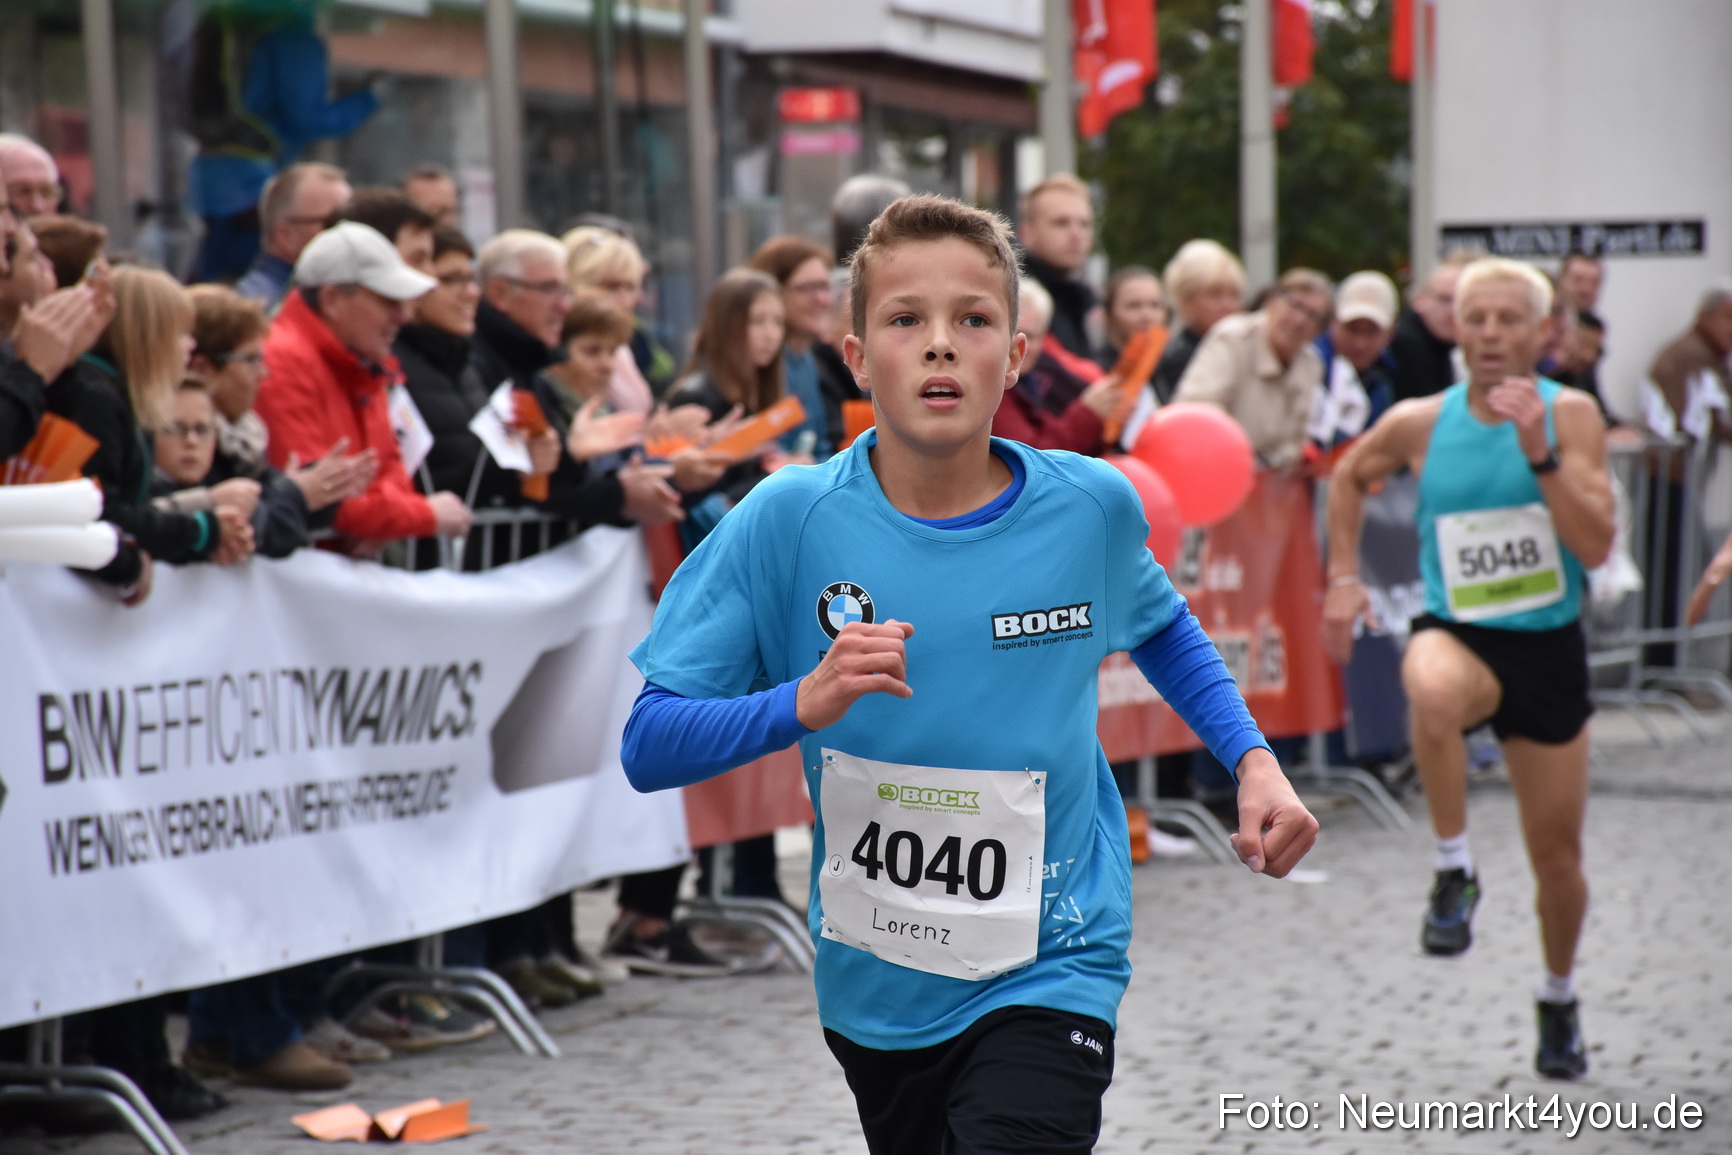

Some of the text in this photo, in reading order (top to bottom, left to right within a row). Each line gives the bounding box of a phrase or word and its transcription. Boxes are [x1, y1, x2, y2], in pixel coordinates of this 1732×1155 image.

[1458, 537, 1541, 579] 5048
[822, 584, 870, 606] BMW
[992, 603, 1092, 639] BOCK
[992, 631, 1093, 651] inspired by smart concepts
[900, 803, 924, 812] inspired
[953, 808, 980, 816] concepts
[901, 785, 980, 809] BOCK
[851, 820, 1007, 901] 4040
[872, 907, 951, 945] Lorenz
